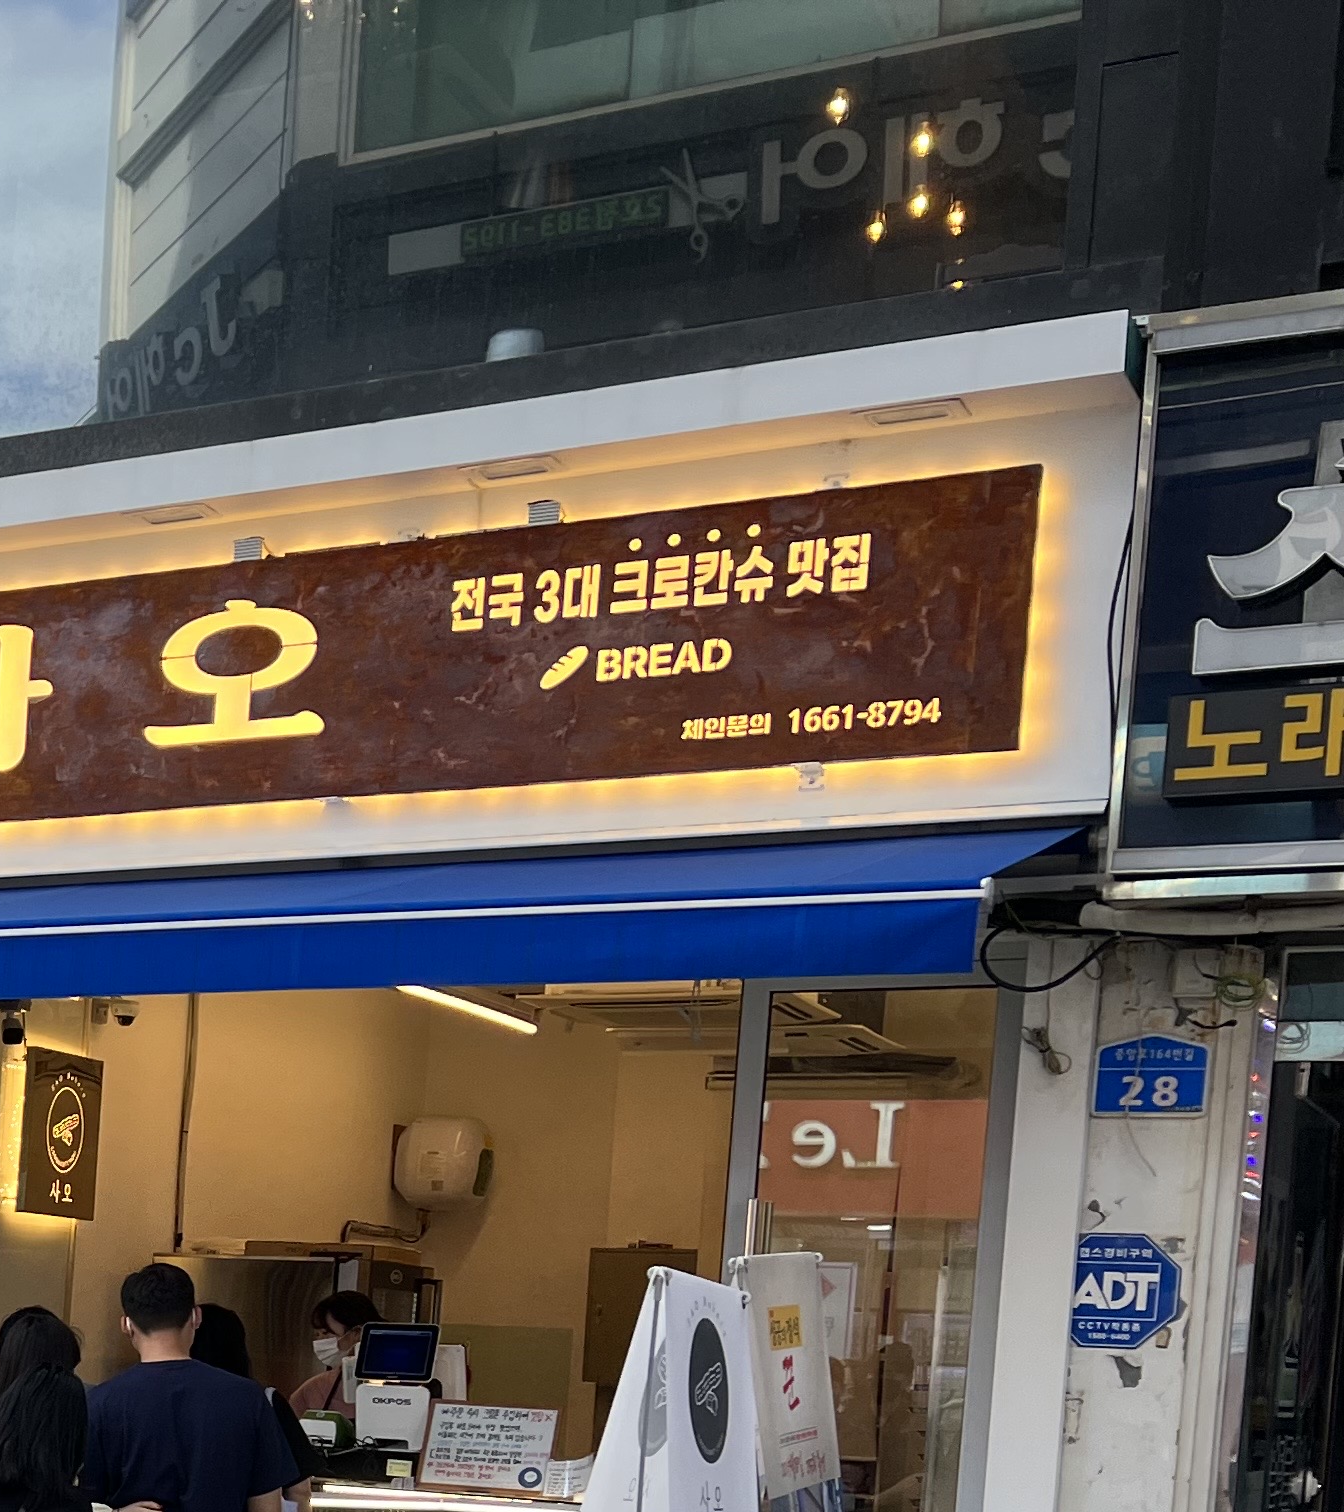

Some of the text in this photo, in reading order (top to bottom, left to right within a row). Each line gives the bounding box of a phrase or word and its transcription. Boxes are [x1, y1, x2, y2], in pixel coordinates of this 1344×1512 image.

[450, 531, 872, 632] 전국 3대 크로칸슈 맛집
[596, 639, 732, 682] BREAD
[681, 697, 941, 740] 체인문의 1661-8794
[1119, 1075, 1179, 1107] 28
[49, 1179, 73, 1203] 사오
[1073, 1271, 1160, 1311] ADT
[372, 1397, 411, 1405] OKPOS
